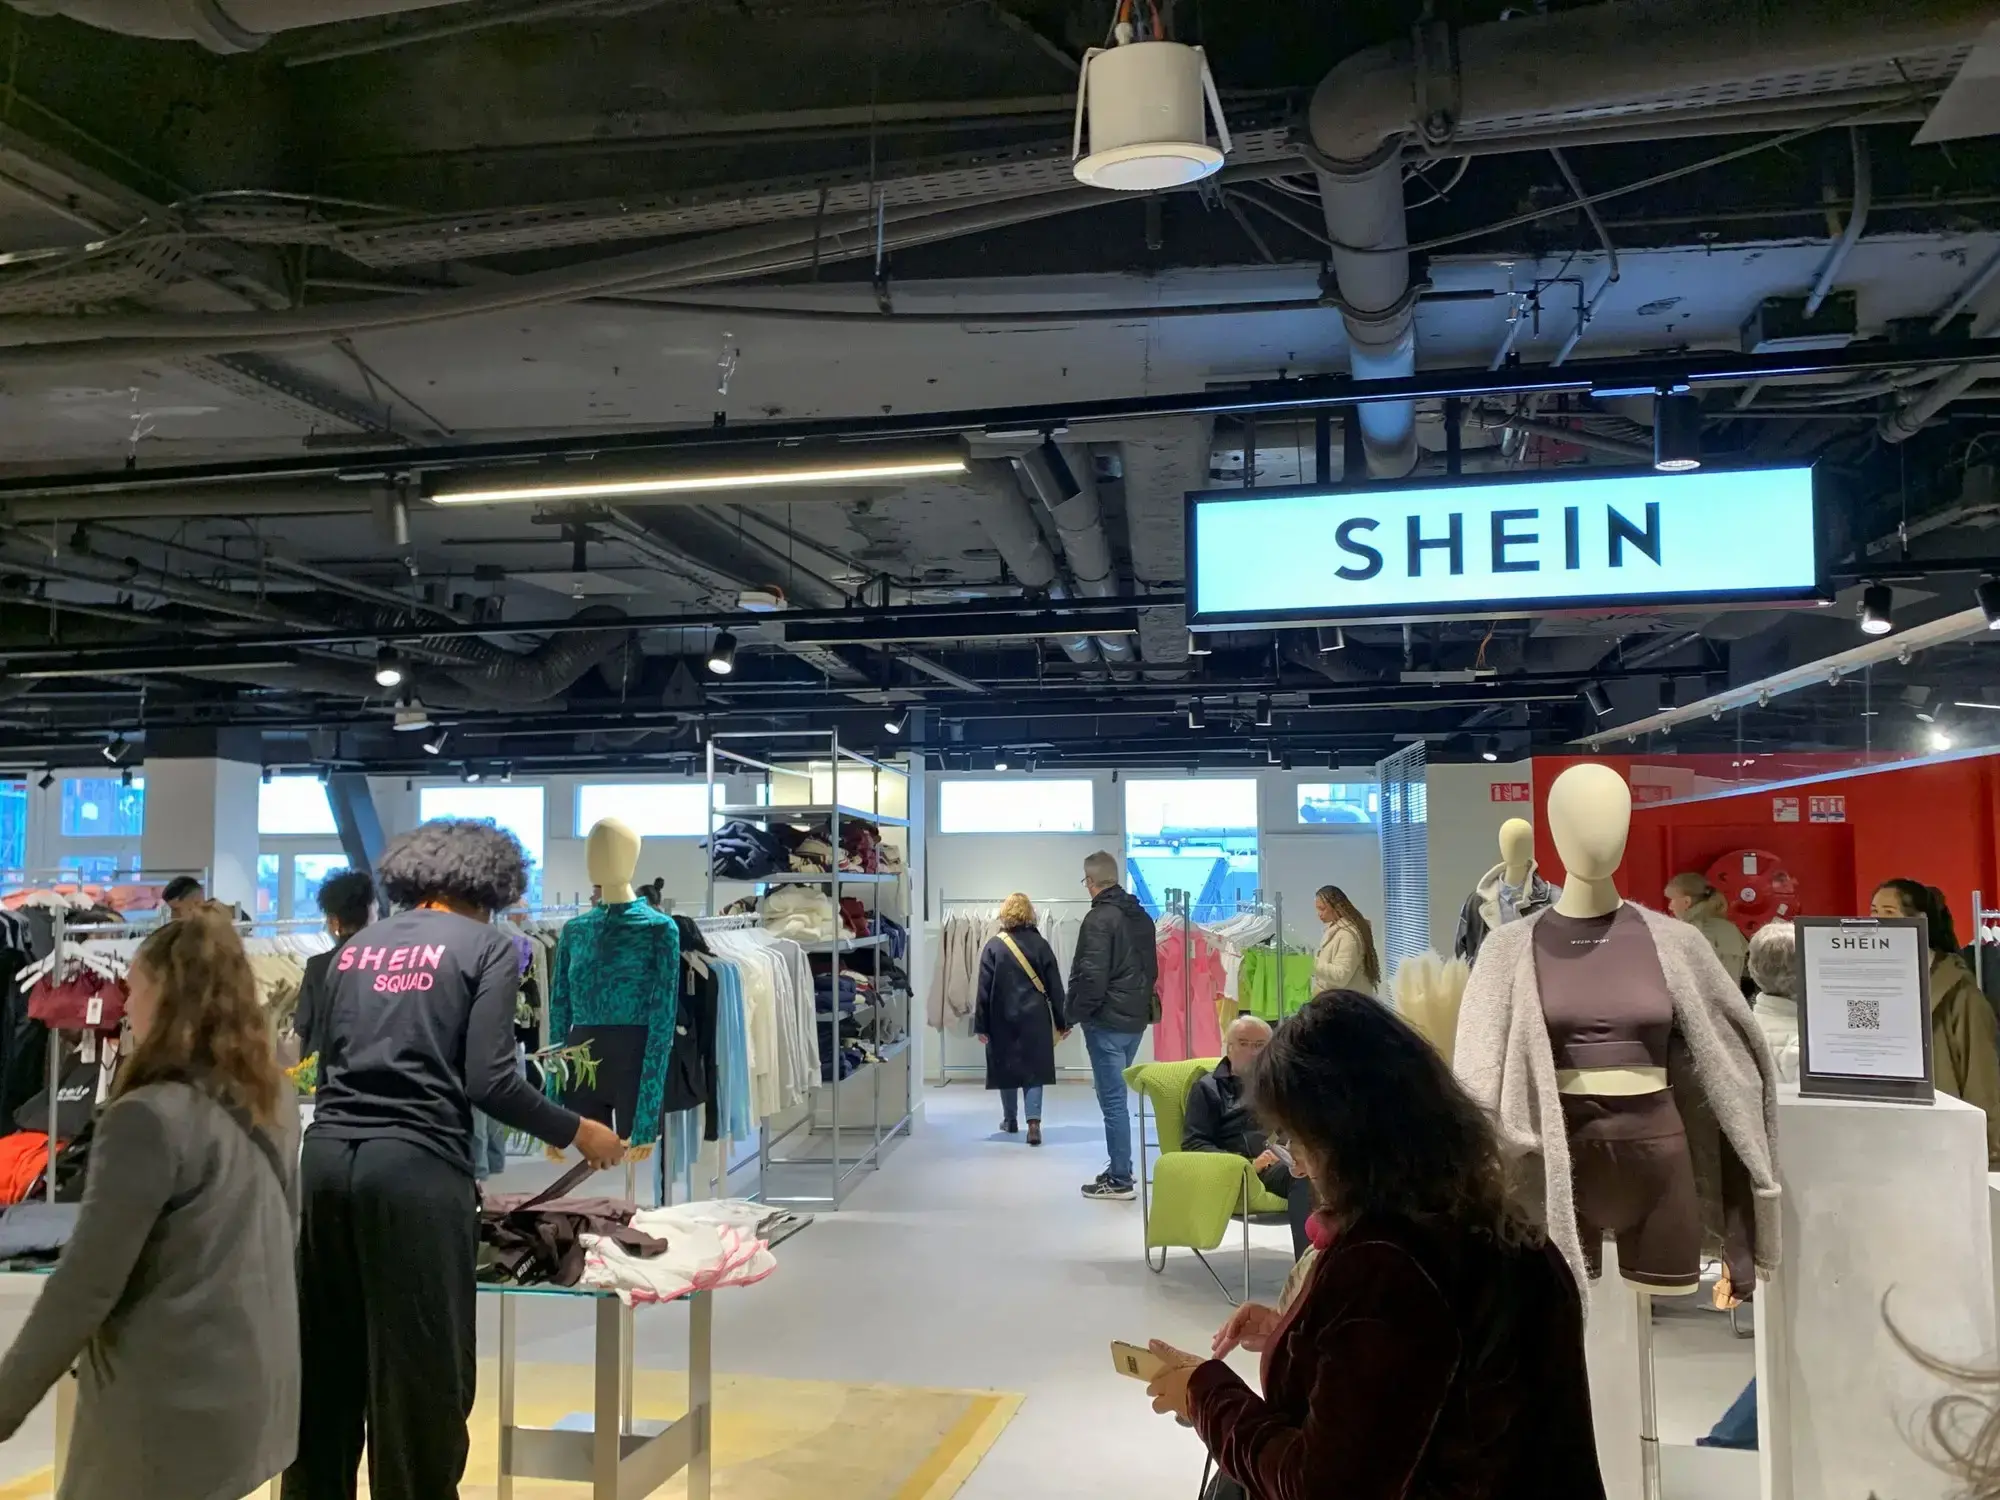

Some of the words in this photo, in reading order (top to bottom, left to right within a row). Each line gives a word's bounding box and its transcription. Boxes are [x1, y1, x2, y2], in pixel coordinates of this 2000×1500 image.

[1335, 502, 1662, 580] SHEIN
[1831, 937, 1890, 949] SHEIN
[338, 945, 446, 971] SHEIN
[374, 973, 433, 993] SQUAD
